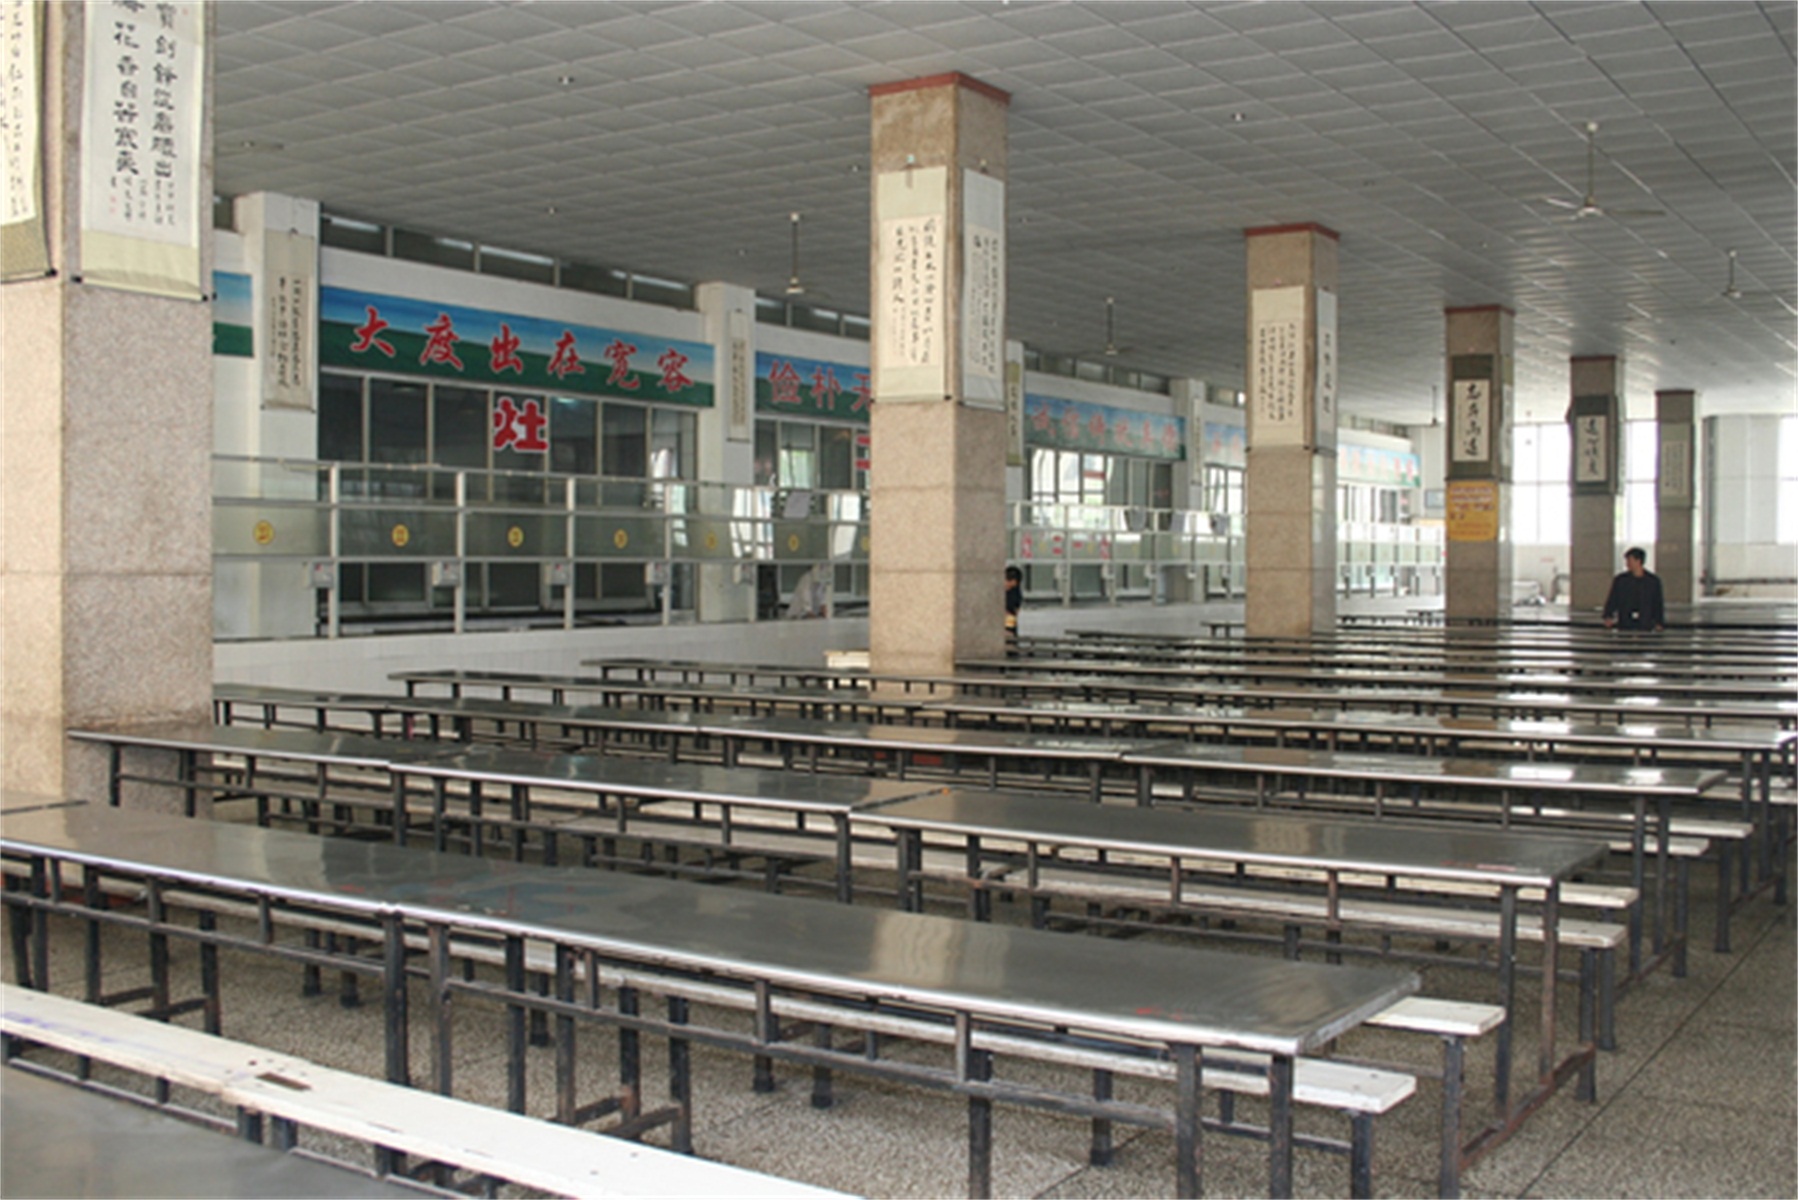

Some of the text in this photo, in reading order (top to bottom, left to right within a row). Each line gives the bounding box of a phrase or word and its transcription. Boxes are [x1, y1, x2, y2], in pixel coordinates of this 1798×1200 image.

[350, 305, 694, 392] 大度出在宽容
[494, 397, 548, 452] 灶
